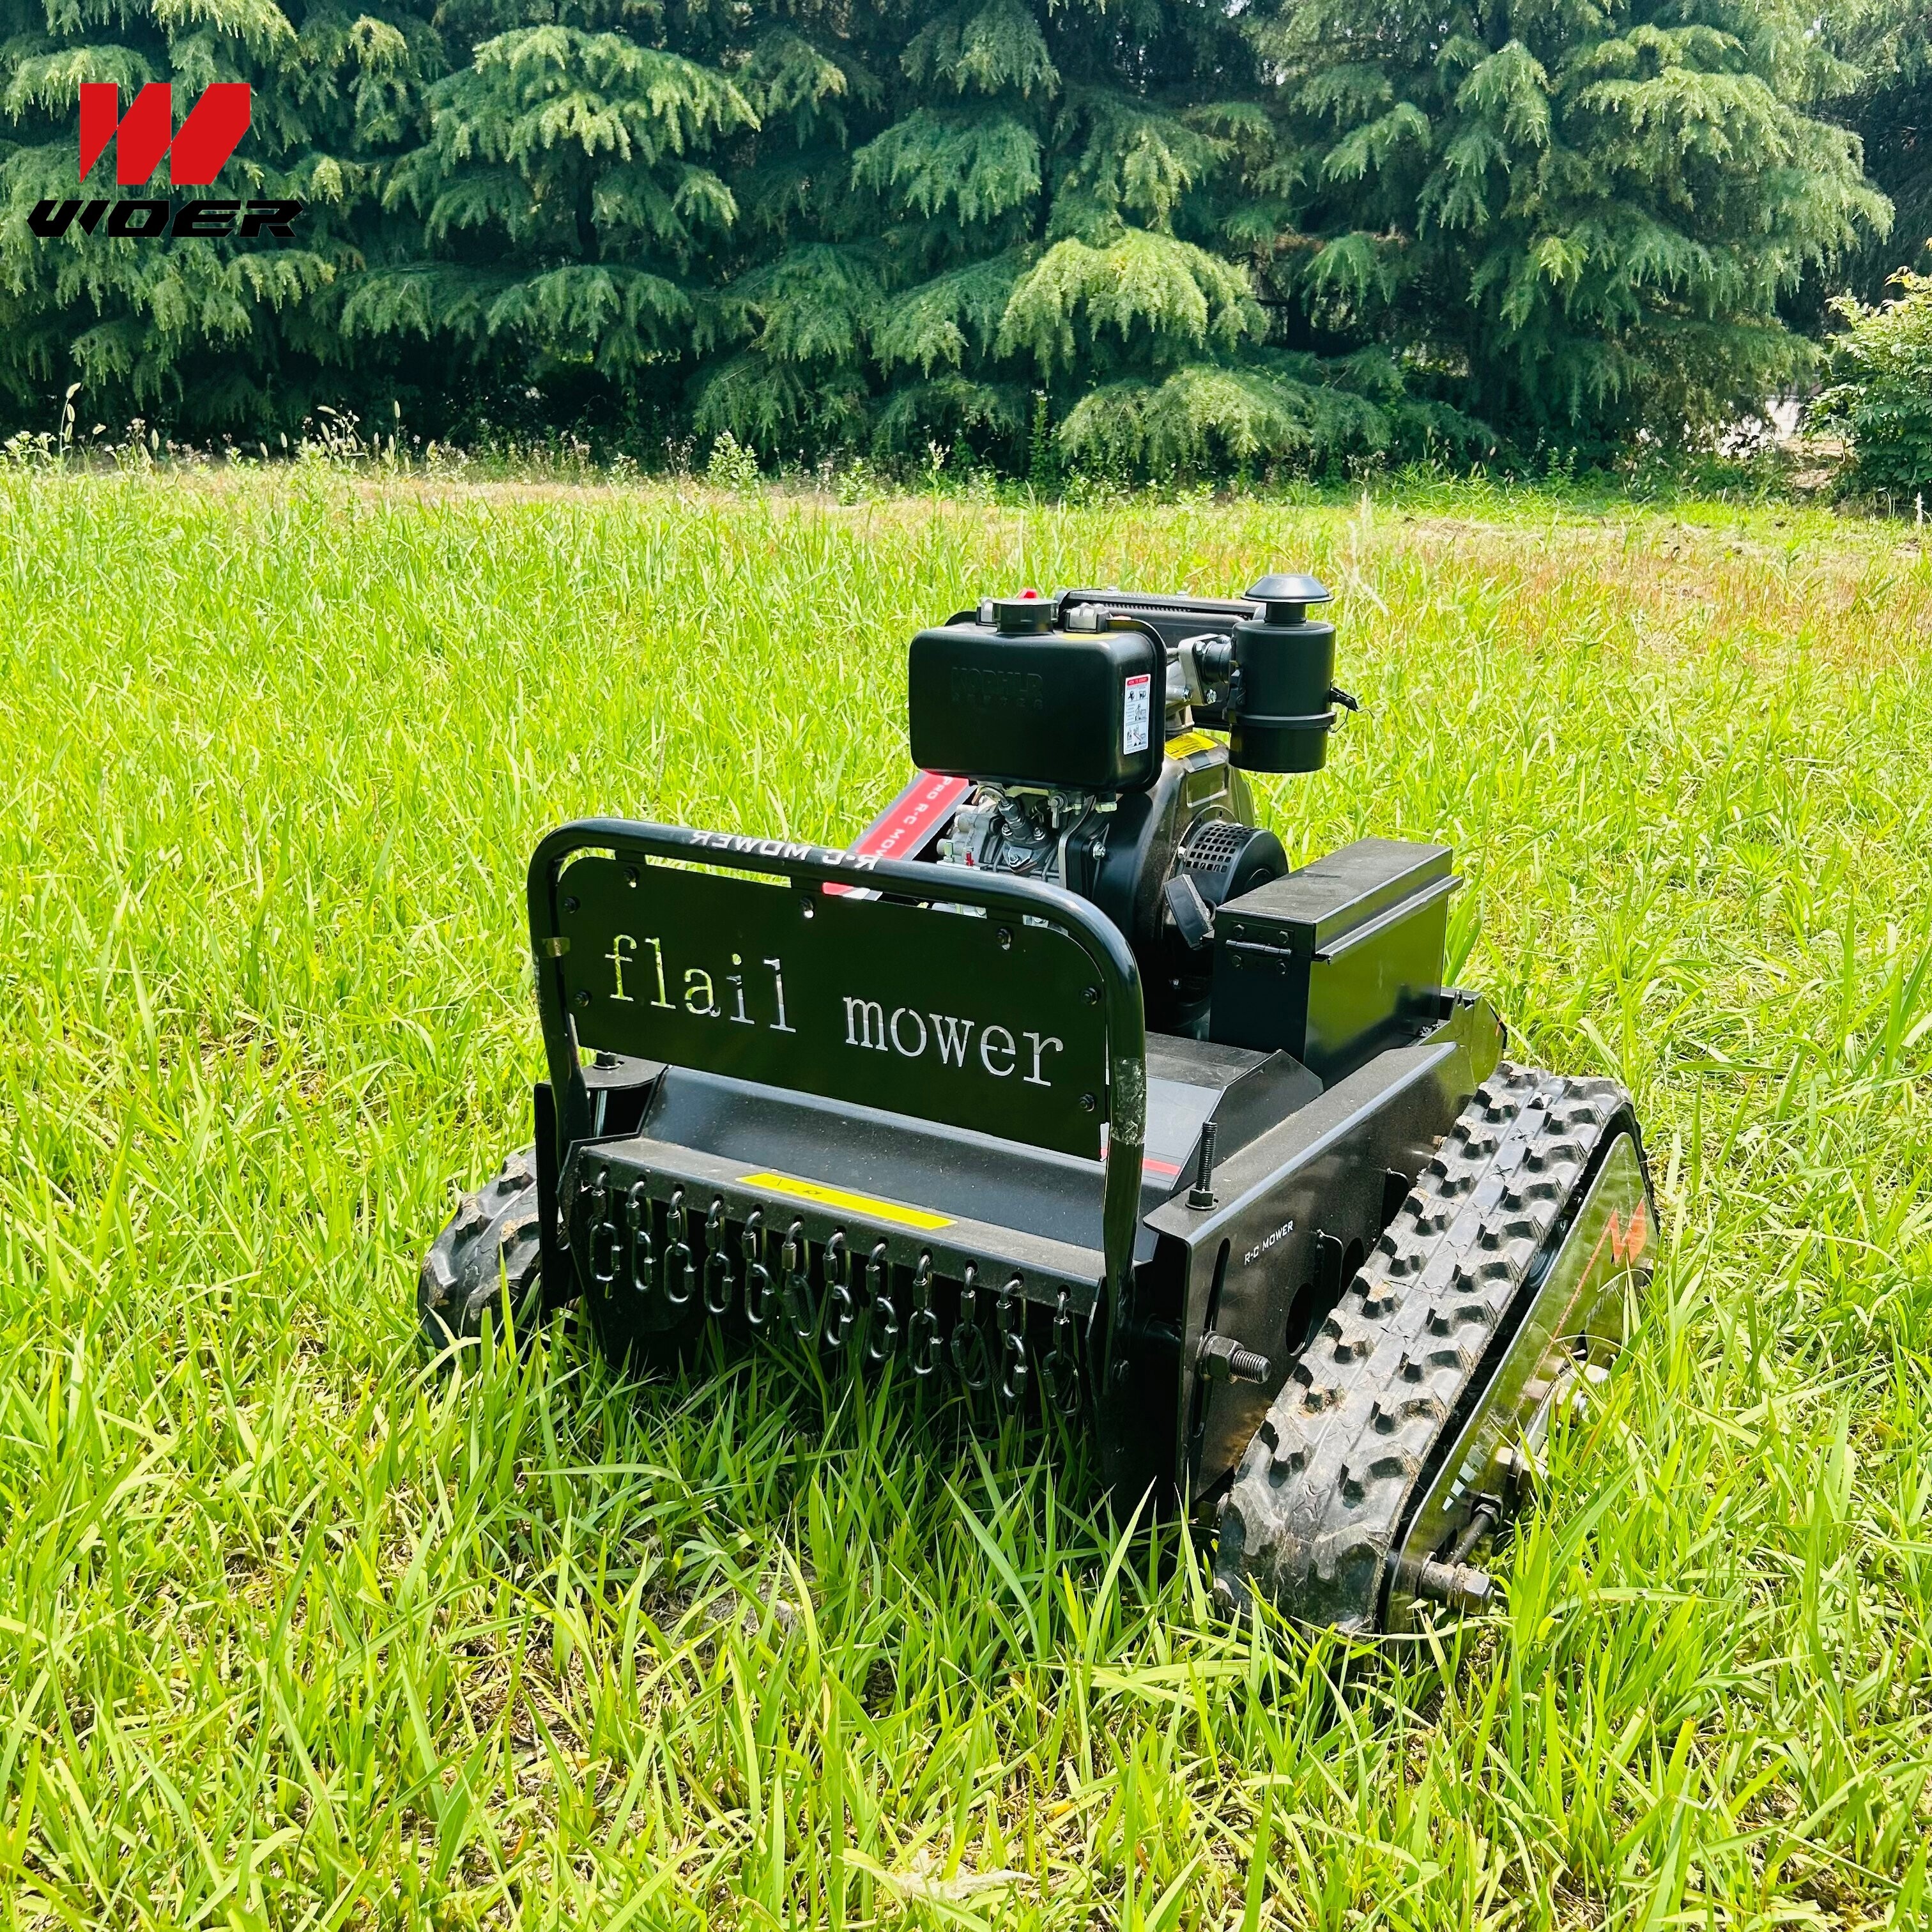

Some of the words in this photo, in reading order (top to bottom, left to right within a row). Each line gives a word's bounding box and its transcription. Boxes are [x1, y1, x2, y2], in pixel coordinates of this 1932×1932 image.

[926, 776, 954, 800] PRO
[605, 934, 797, 1033] flail
[843, 996, 1064, 1087] mower
[1262, 1220, 1293, 1252] MOWER
